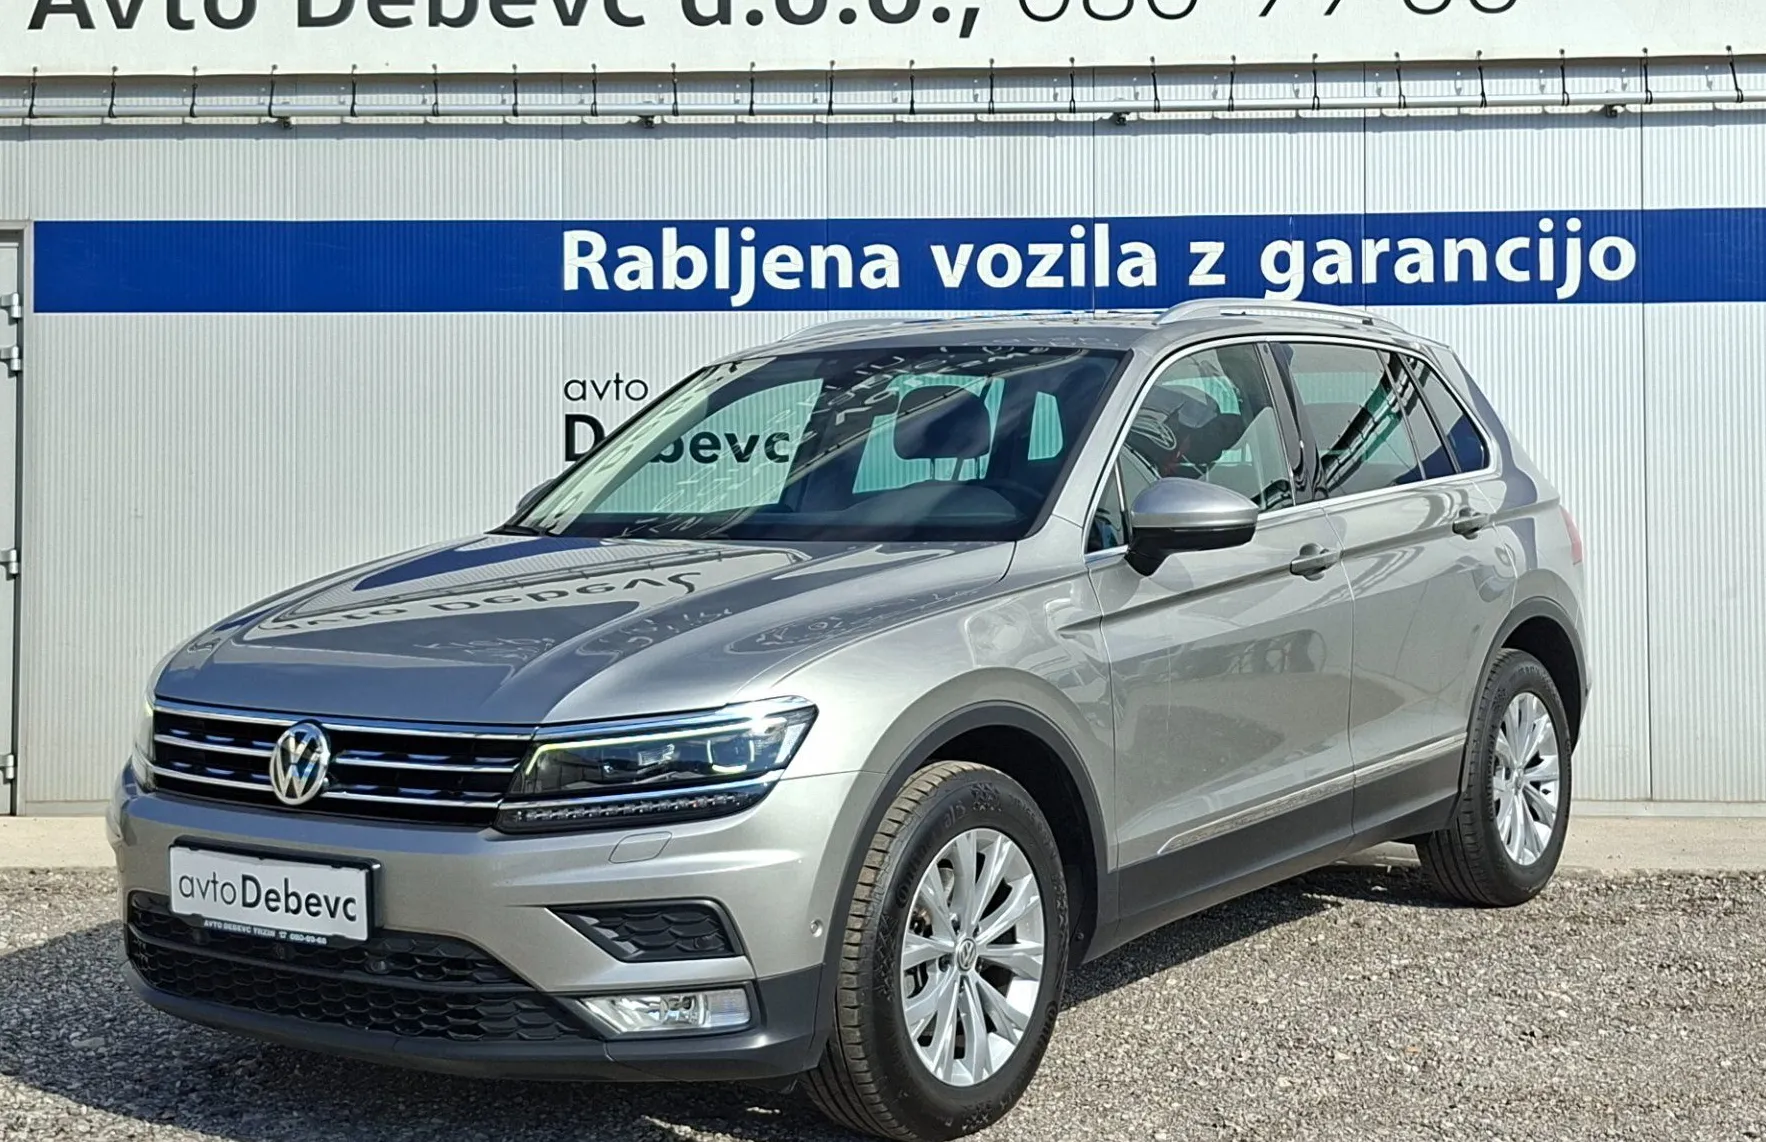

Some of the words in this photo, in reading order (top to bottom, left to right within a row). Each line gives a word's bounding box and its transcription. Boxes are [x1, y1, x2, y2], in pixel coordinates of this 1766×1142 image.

[562, 226, 900, 308] Rabljena
[930, 222, 1158, 288] vozila
[1188, 240, 1227, 287] z
[1259, 216, 1637, 300] garancijo
[563, 372, 649, 402] avto
[564, 413, 790, 464] Devc
[178, 871, 358, 923] avtoDebevc
[203, 919, 223, 930] AVTO
